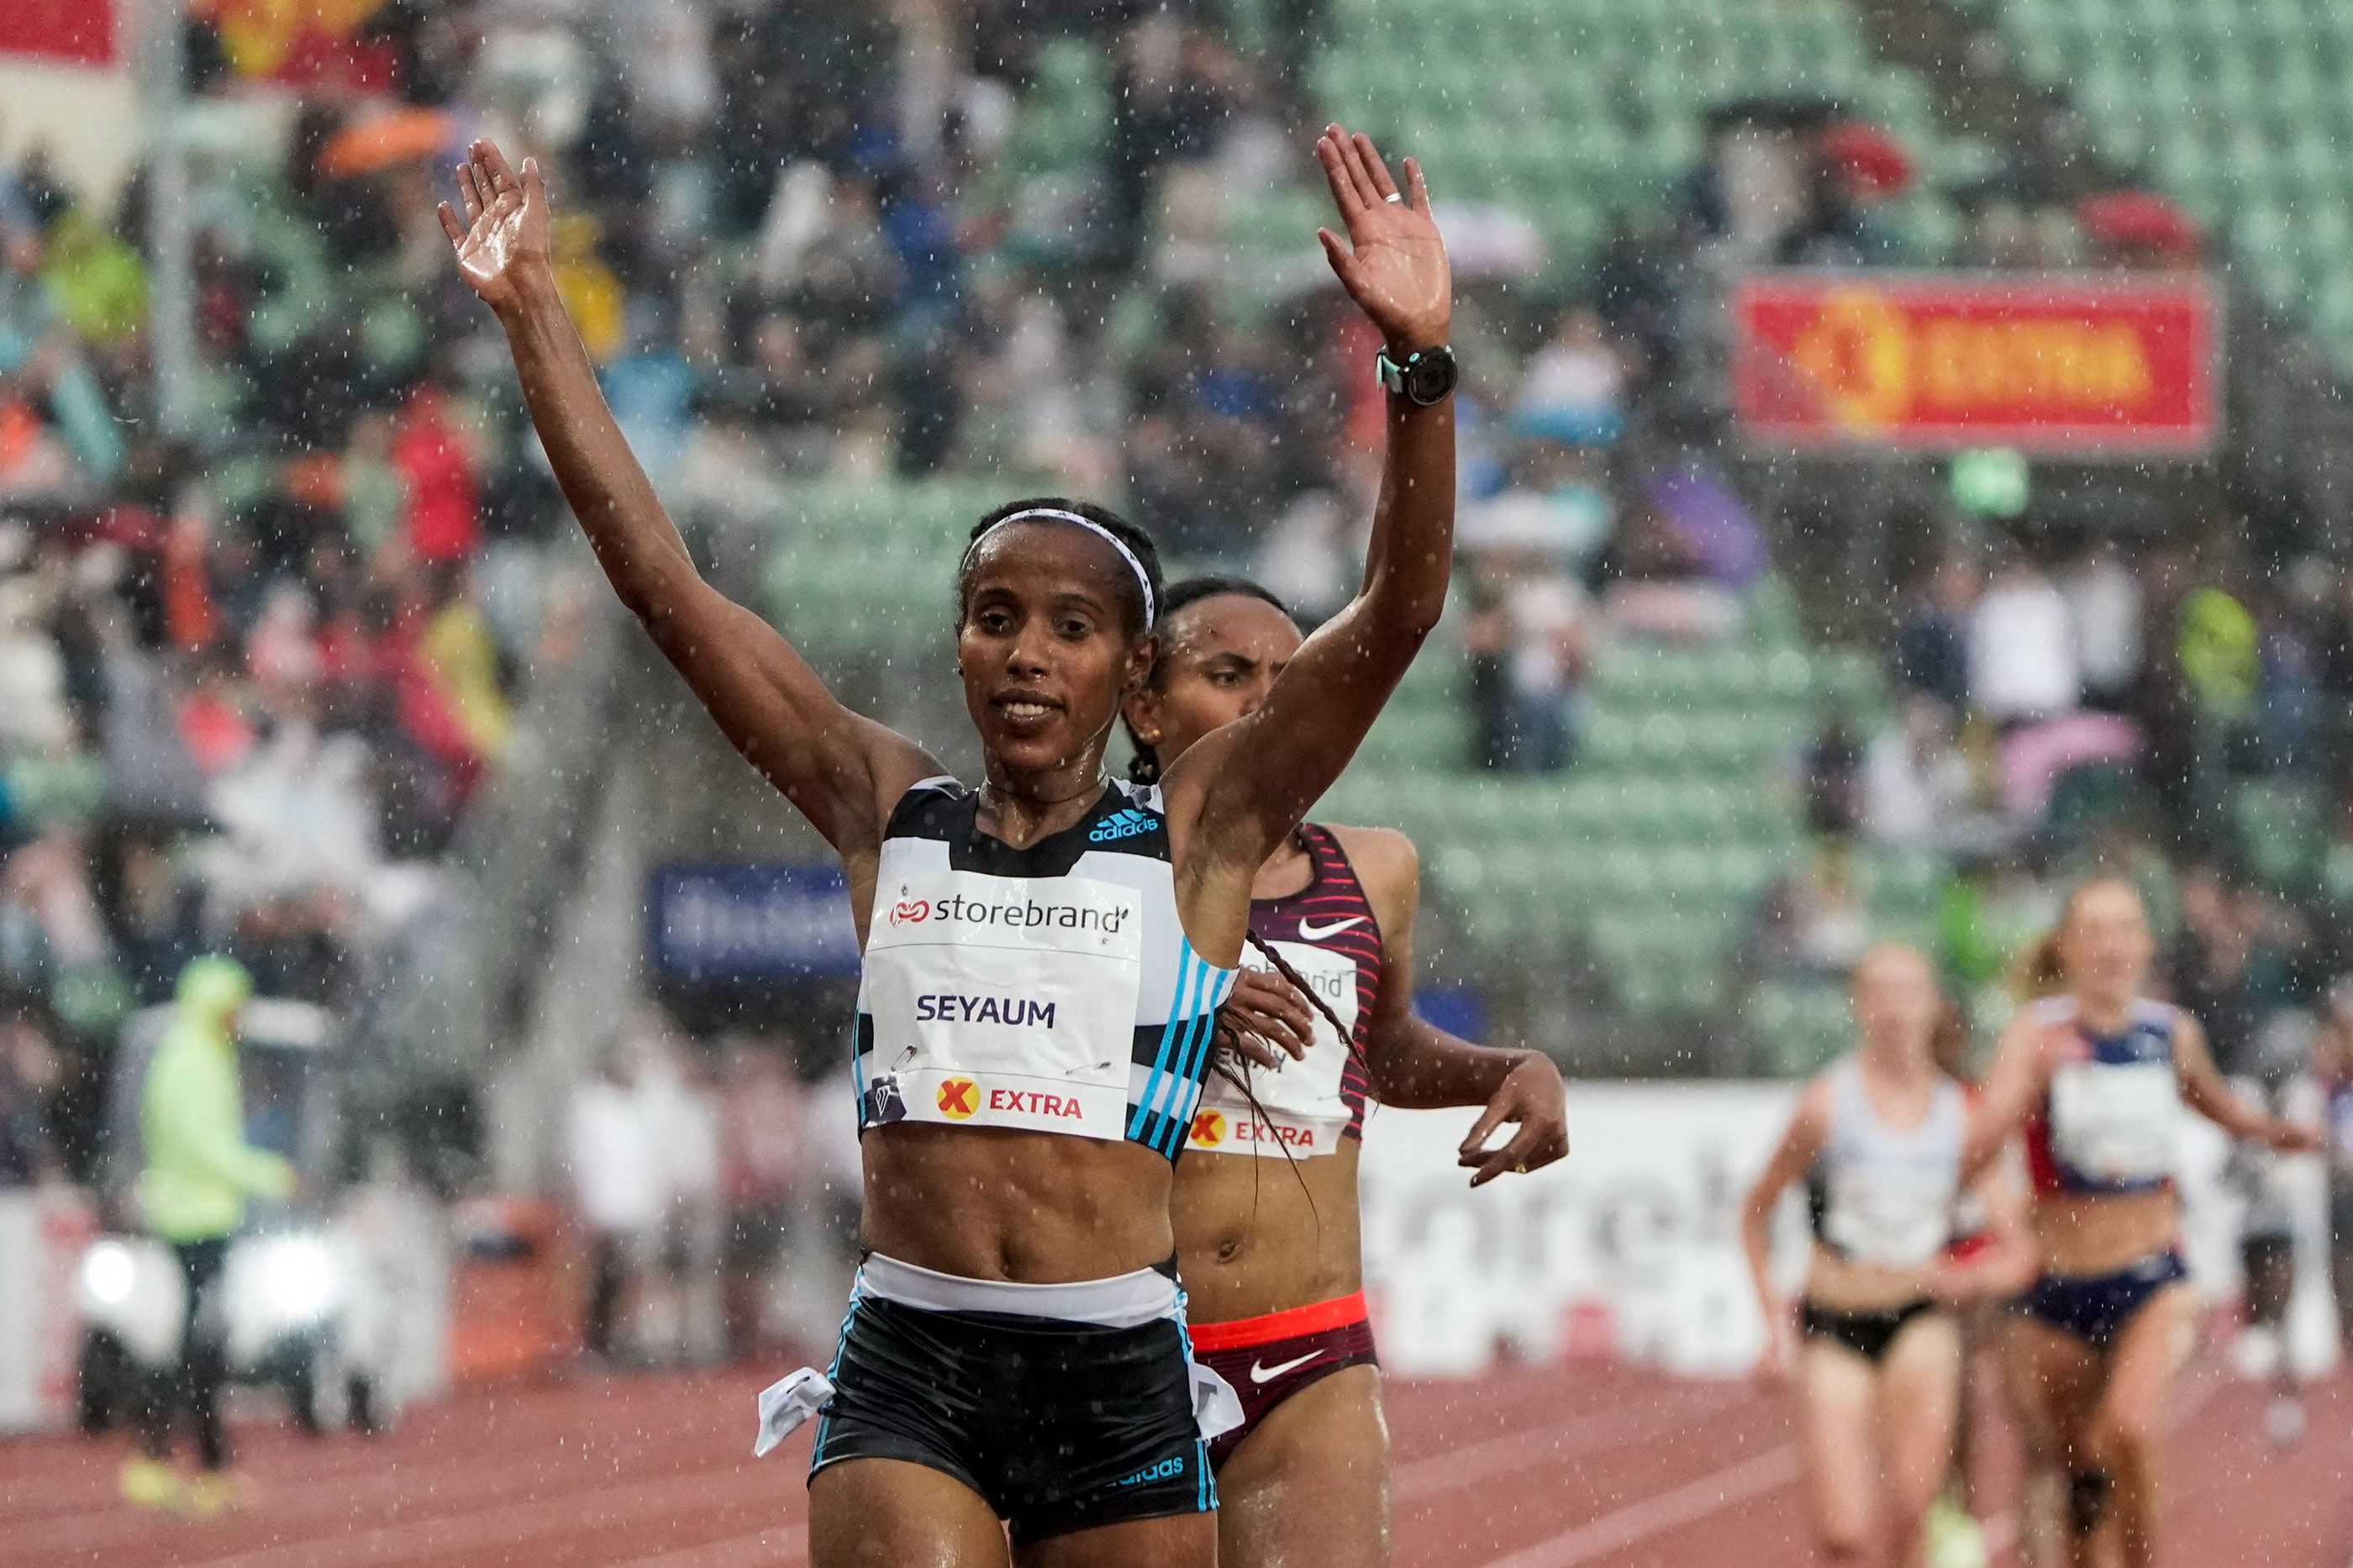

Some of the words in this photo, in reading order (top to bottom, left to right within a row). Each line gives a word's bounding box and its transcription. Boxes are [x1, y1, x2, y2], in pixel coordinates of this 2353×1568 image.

[1089, 818, 1158, 841] adidas
[934, 893, 1120, 934] storebrand
[916, 994, 1056, 1029] SEYAUM
[989, 1089, 1083, 1120] EXTRA
[1234, 1122, 1314, 1146] EXTRA
